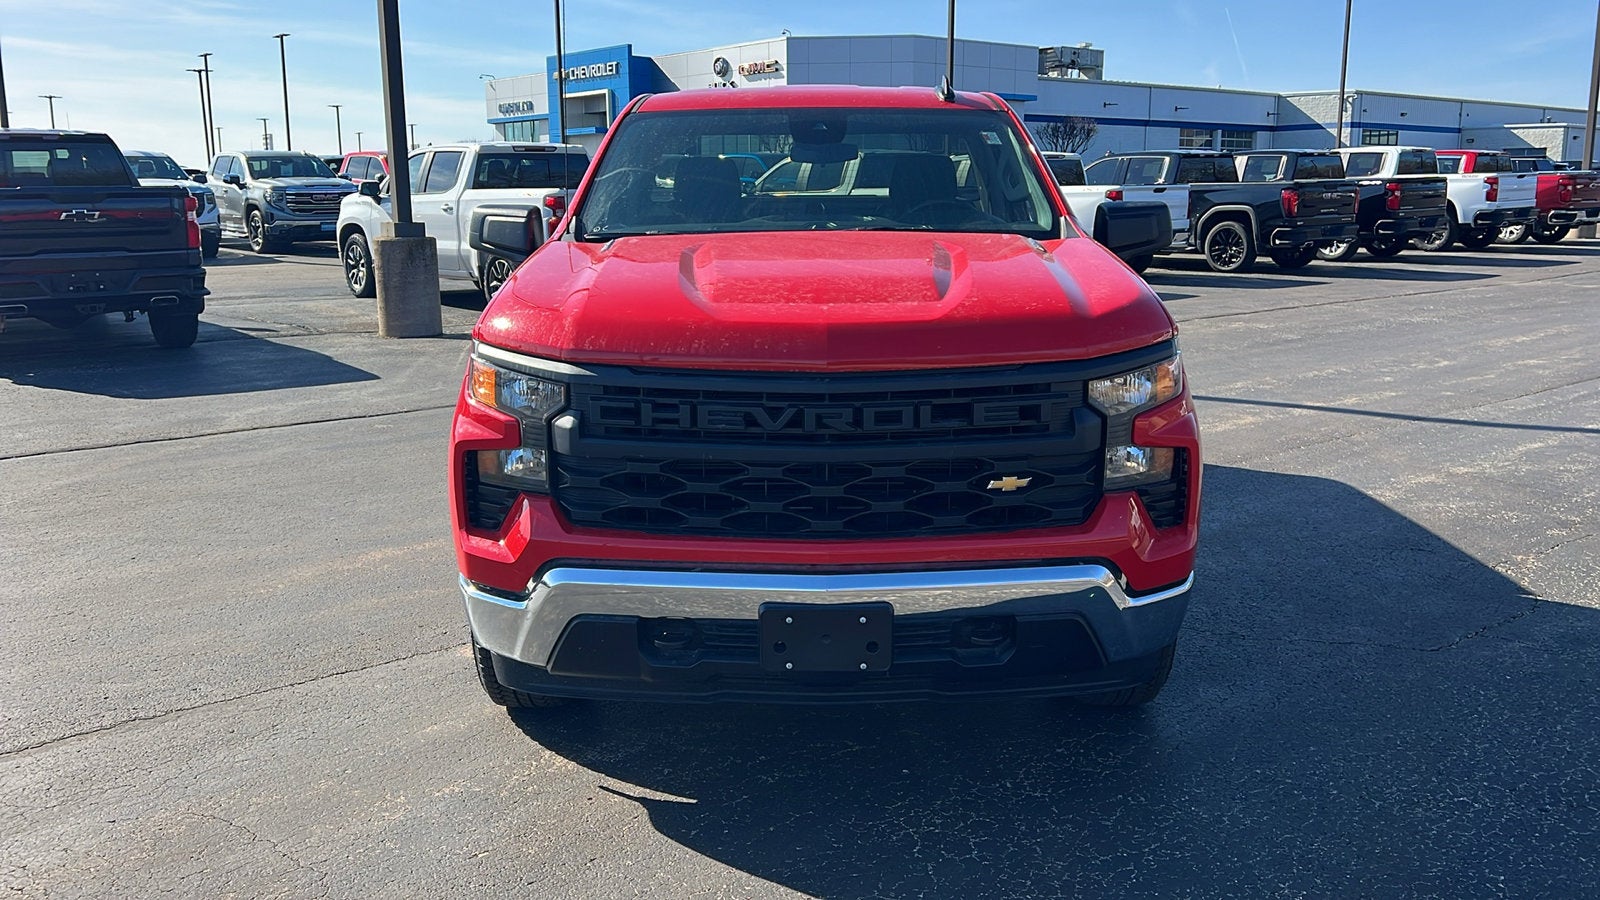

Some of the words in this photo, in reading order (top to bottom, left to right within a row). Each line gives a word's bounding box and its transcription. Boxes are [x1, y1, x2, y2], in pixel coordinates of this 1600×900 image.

[569, 61, 618, 80] CHEVROLET
[738, 60, 777, 75] GMC
[587, 397, 1065, 433] CHEVROLET
